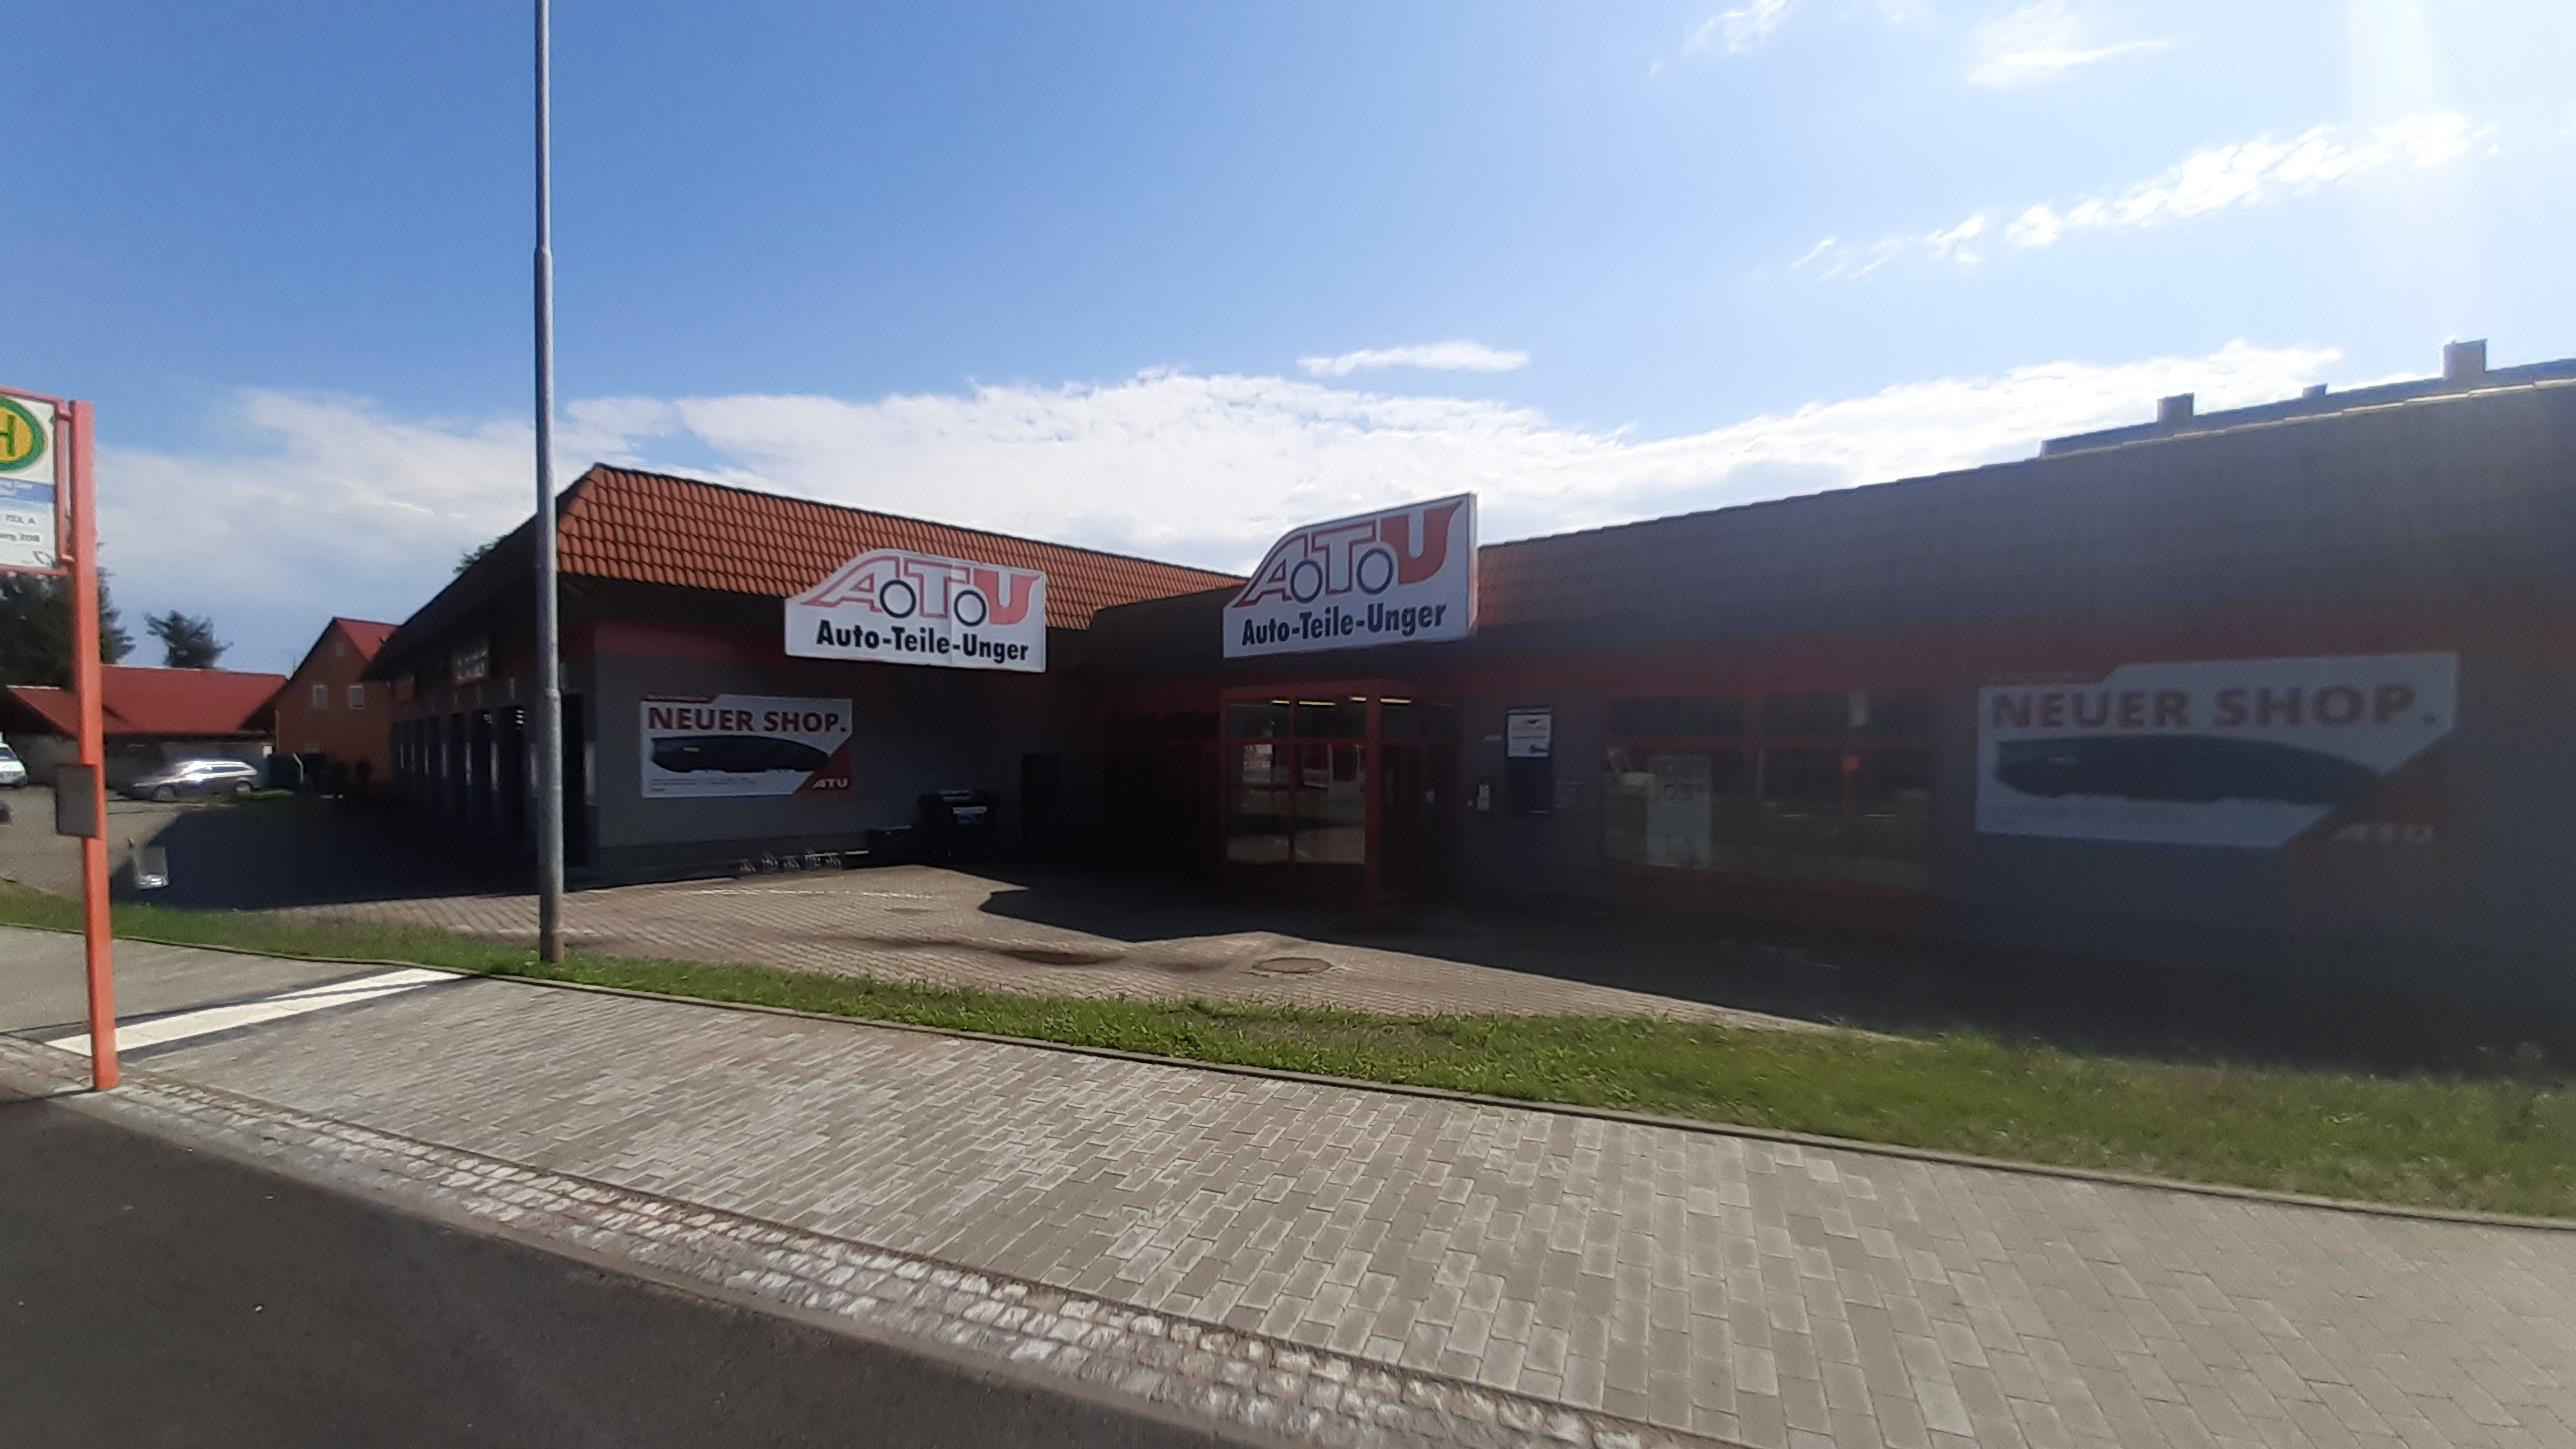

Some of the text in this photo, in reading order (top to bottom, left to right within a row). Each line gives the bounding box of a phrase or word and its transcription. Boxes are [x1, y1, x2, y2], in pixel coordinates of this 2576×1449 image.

[816, 619, 1029, 664] Auto-Teile-Unger
[1241, 603, 1447, 646] Auto-Teile-Unger
[648, 707, 848, 733] NEUER SHOP.
[1991, 682, 2438, 729] NEUER SHOP.
[812, 777, 849, 789] ATU
